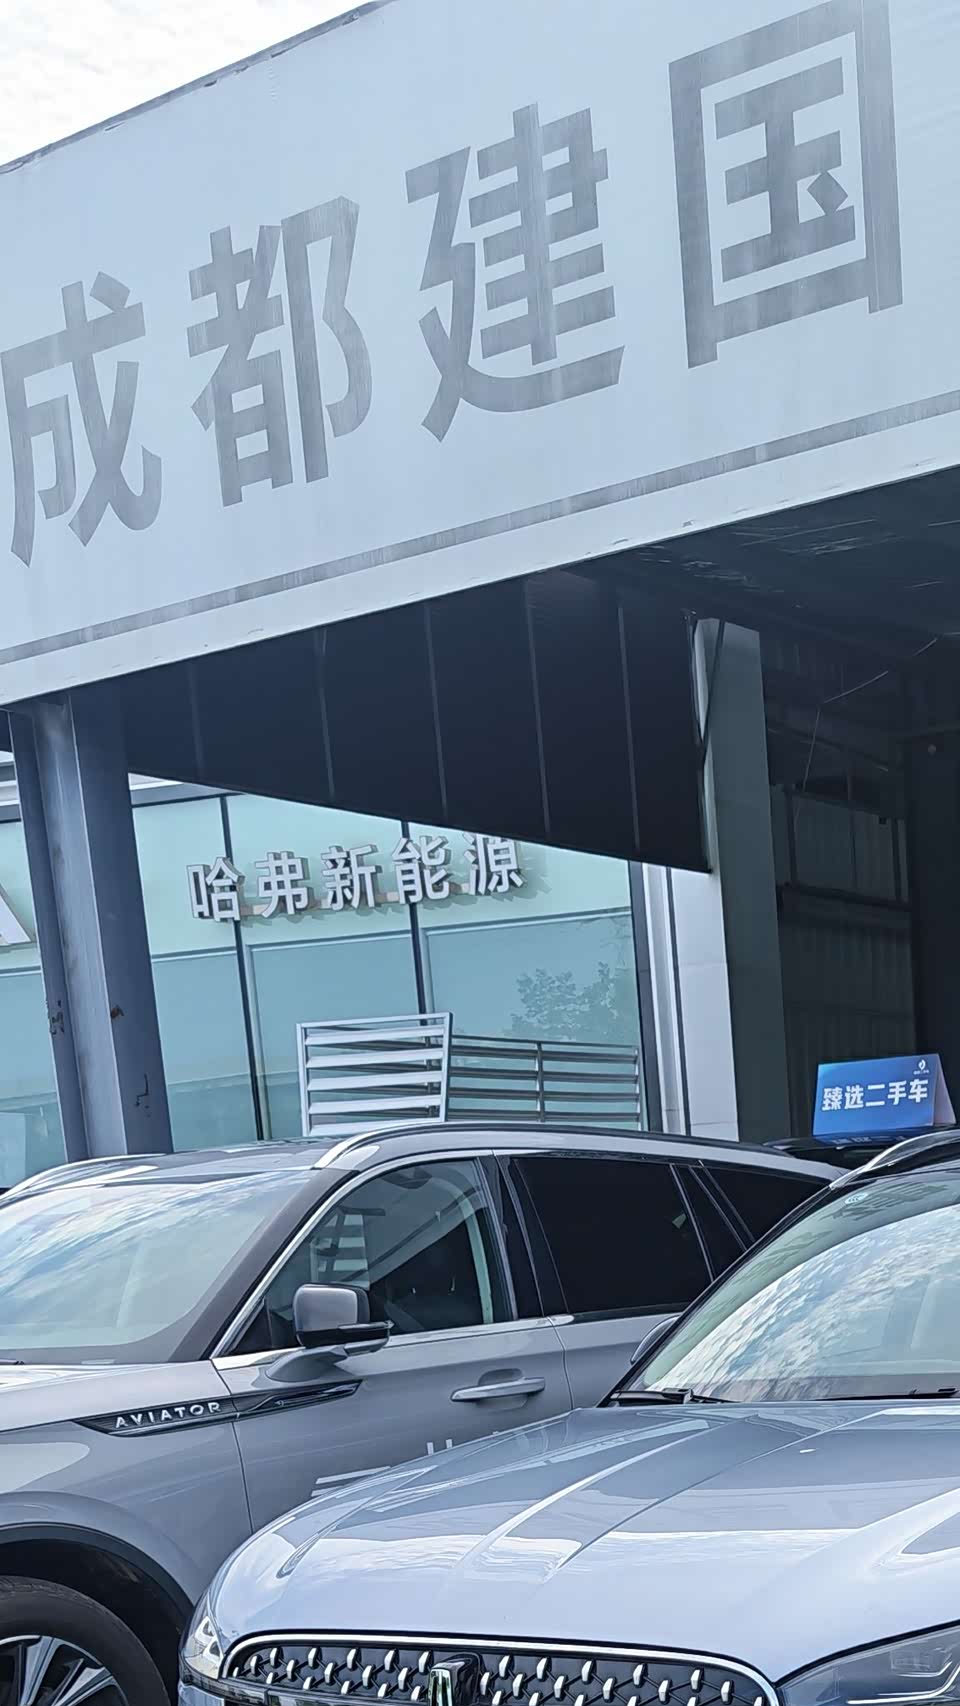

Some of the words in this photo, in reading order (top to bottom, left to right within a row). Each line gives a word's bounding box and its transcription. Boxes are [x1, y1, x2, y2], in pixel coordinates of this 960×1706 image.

[186, 832, 526, 922] 哈弗新能源
[821, 1078, 929, 1112] 臻选二手车
[114, 1401, 222, 1429] AVIATOR
